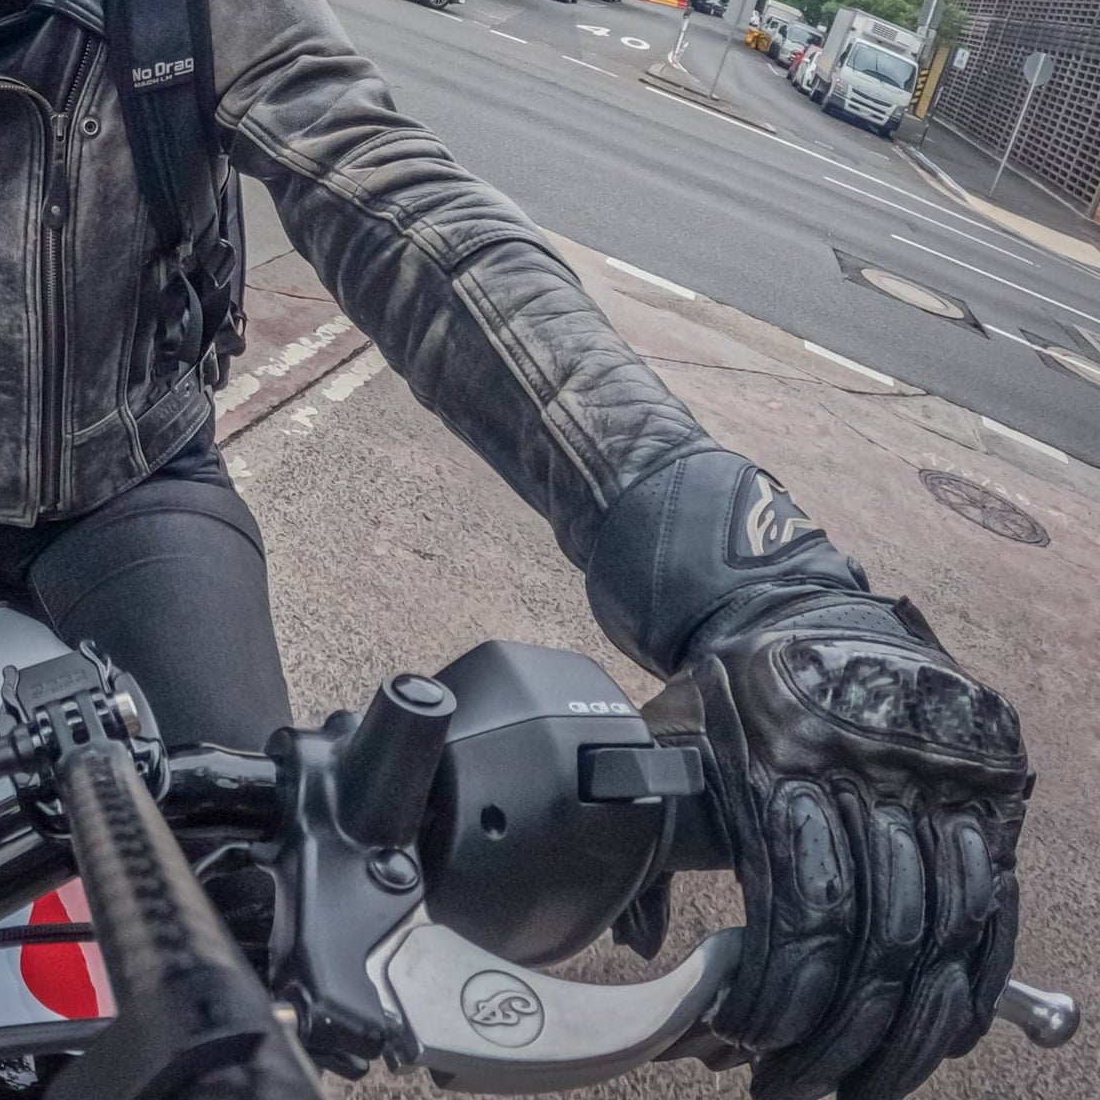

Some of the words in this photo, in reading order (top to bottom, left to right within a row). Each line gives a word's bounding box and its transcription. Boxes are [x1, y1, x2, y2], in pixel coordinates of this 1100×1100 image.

[575, 24, 650, 50] 40
[132, 68, 152, 81] No
[154, 57, 194, 77] Drag
